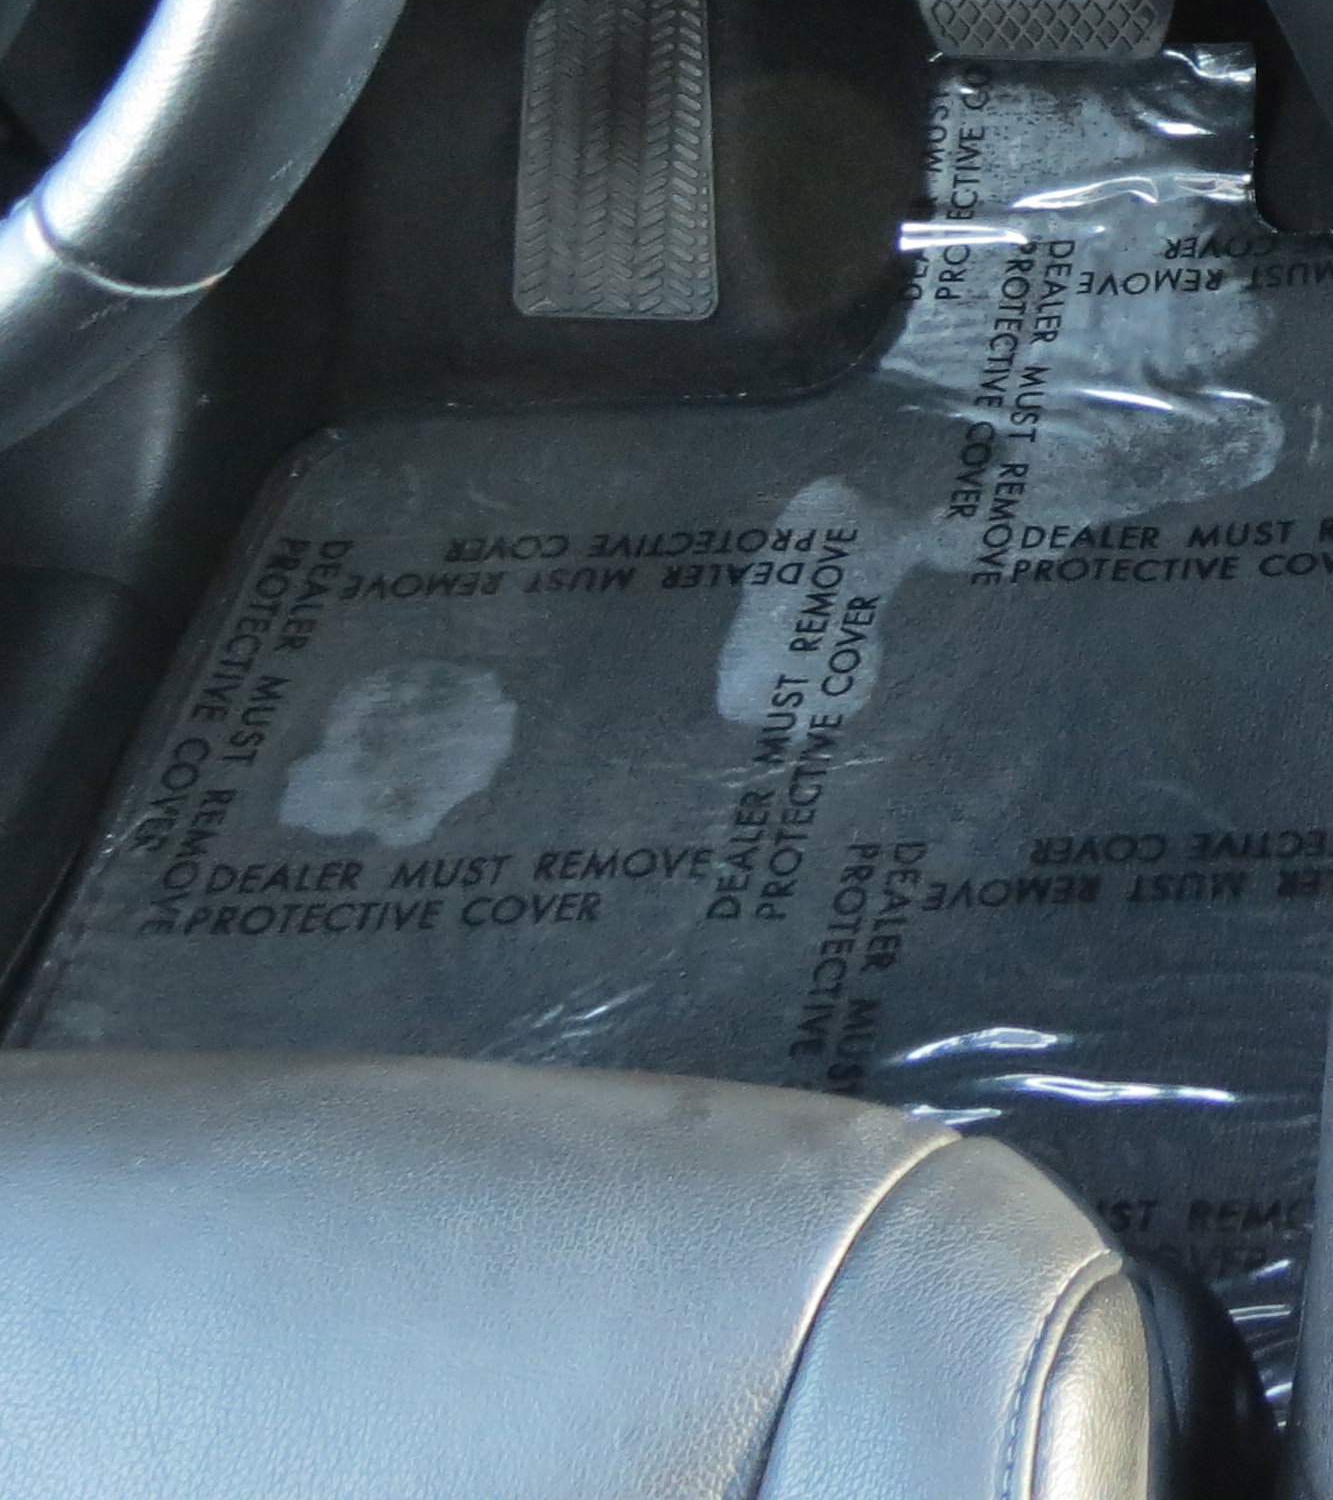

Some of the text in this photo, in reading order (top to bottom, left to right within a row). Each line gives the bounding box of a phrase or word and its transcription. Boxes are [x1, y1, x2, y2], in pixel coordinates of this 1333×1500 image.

[935, 126, 986, 301] PROECTIVE
[1076, 267, 1225, 296] REMOVE
[947, 240, 1038, 521] PROTECTIVE COVER
[970, 239, 1076, 587] DEALER MUST REMOVE
[442, 527, 815, 563] PROTECTIVE COVER
[1009, 554, 1240, 584] PROTECTIVE
[1020, 524, 1161, 551] DEALER
[1187, 519, 1298, 549] MUST
[275, 539, 355, 652] DEALER
[342, 562, 803, 600] DEALER MUST REMOVE
[190, 536, 311, 722] PROTECTIVE
[222, 675, 291, 767] MUST
[706, 527, 858, 921] DEALER MUST REMOVE
[754, 594, 882, 921] PROTECTIVE COVER
[205, 846, 717, 896] DEALER MUST REMOVE
[1029, 833, 1168, 867] COVER
[182, 892, 601, 935] PROTECTIVE COVER
[858, 840, 928, 974] DEALER
[922, 874, 1101, 913] REMOVE
[1129, 871, 1247, 902] MUST
[788, 842, 882, 1058] PROTECTIVE
